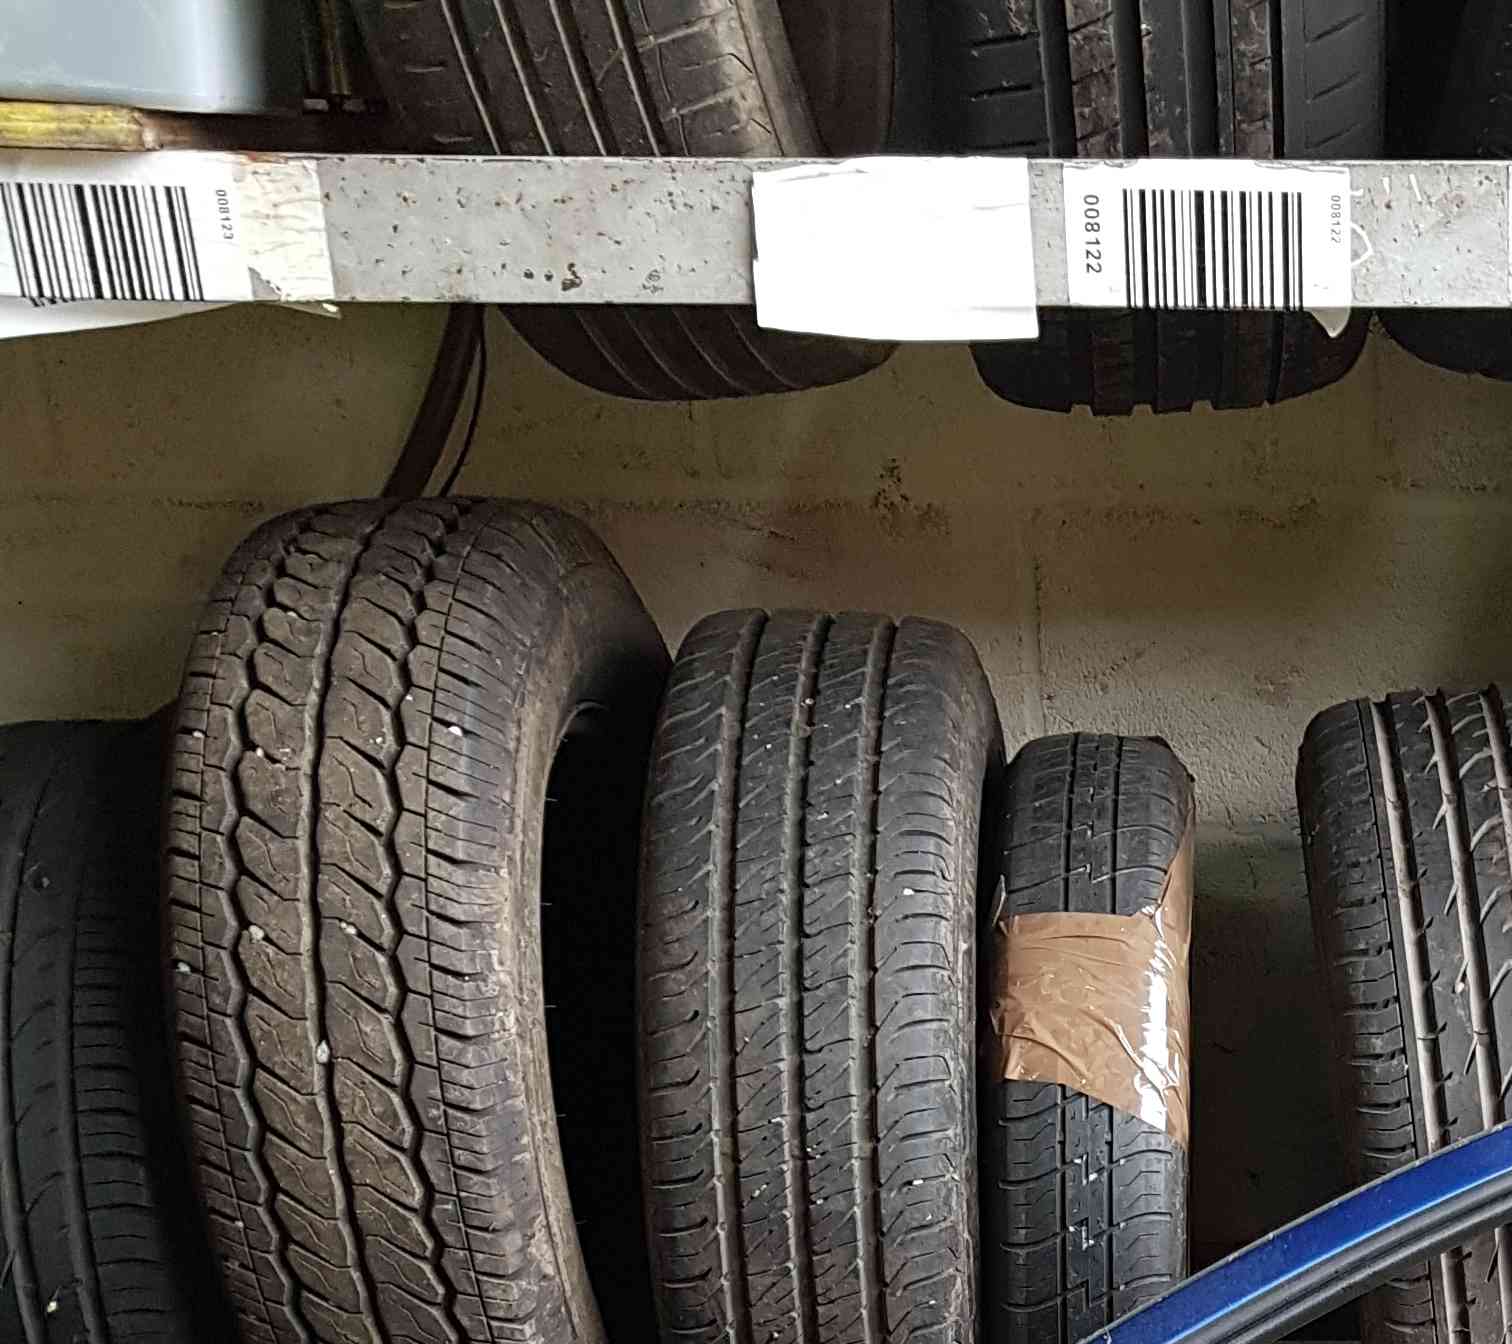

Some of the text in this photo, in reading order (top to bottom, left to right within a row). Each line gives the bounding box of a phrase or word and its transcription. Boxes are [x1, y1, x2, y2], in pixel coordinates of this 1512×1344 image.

[215, 189, 235, 240] 008123
[1083, 194, 1102, 274] 008122
[1330, 194, 1341, 244] 008122
